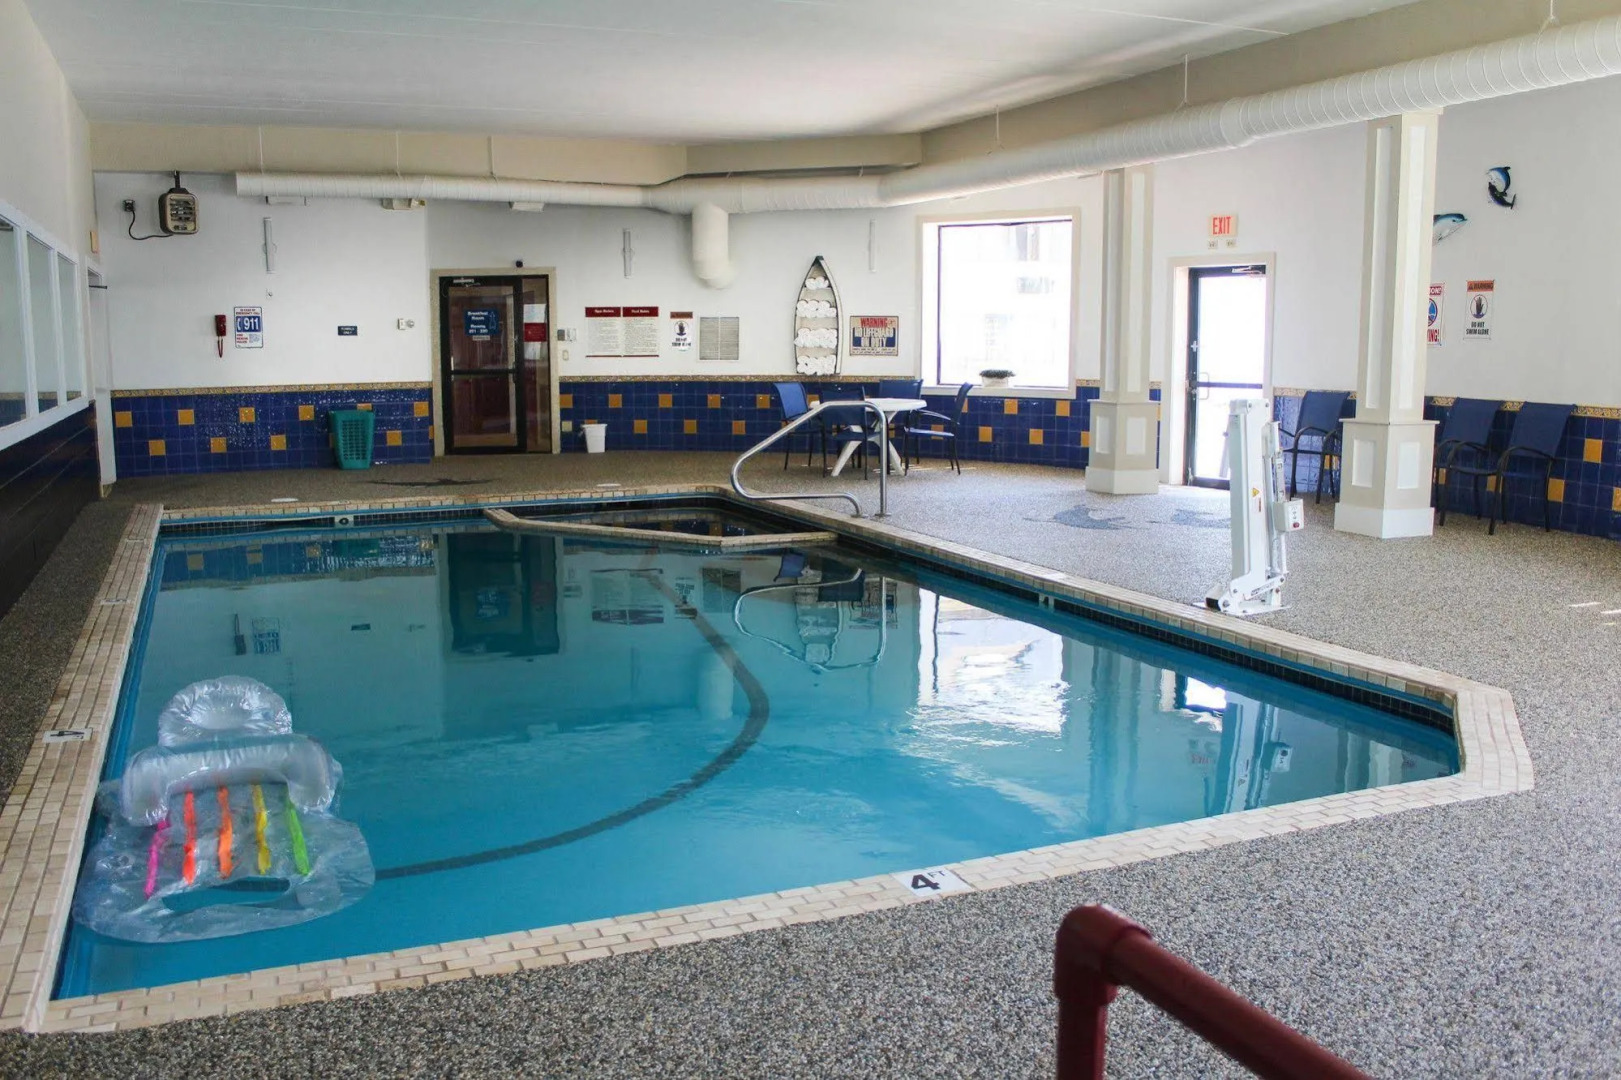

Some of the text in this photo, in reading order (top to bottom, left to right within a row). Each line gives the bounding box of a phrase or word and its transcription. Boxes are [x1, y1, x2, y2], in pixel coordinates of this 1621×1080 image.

[1213, 216, 1231, 234] EXIT
[244, 317, 259, 330] 911
[861, 317, 887, 328] WARNING
[911, 870, 946, 890] 4 FT
